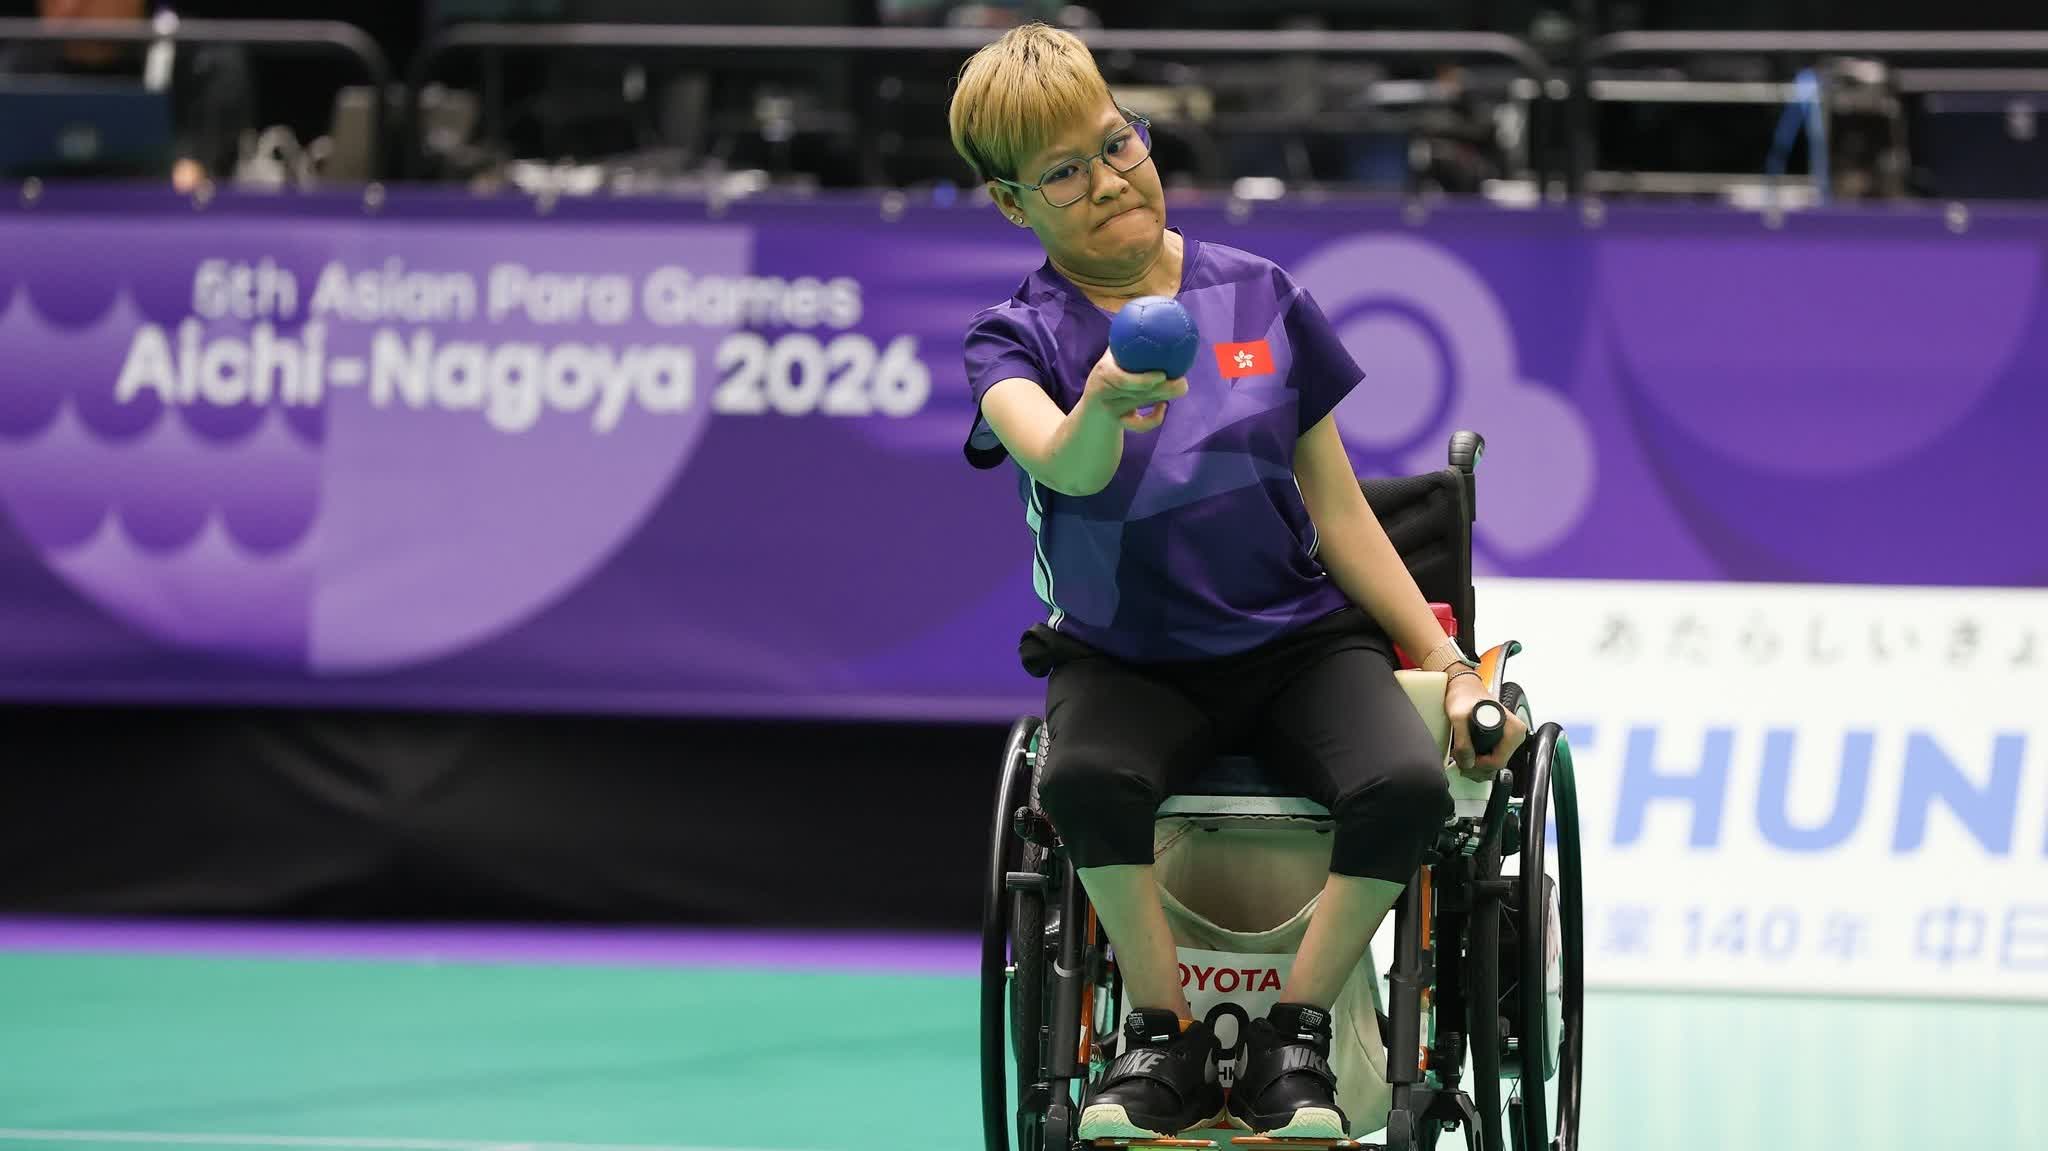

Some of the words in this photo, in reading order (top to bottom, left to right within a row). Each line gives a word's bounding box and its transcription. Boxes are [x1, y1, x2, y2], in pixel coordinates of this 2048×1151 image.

[311, 257, 477, 322] Asian
[488, 264, 634, 325] Para
[643, 265, 863, 328] Games
[114, 317, 696, 434] Aichi-Nagoya
[713, 331, 931, 417] 2026
[1546, 720, 2048, 857] HUN
[1179, 962, 1281, 993] YOTA
[1112, 1050, 1167, 1078] NIKE
